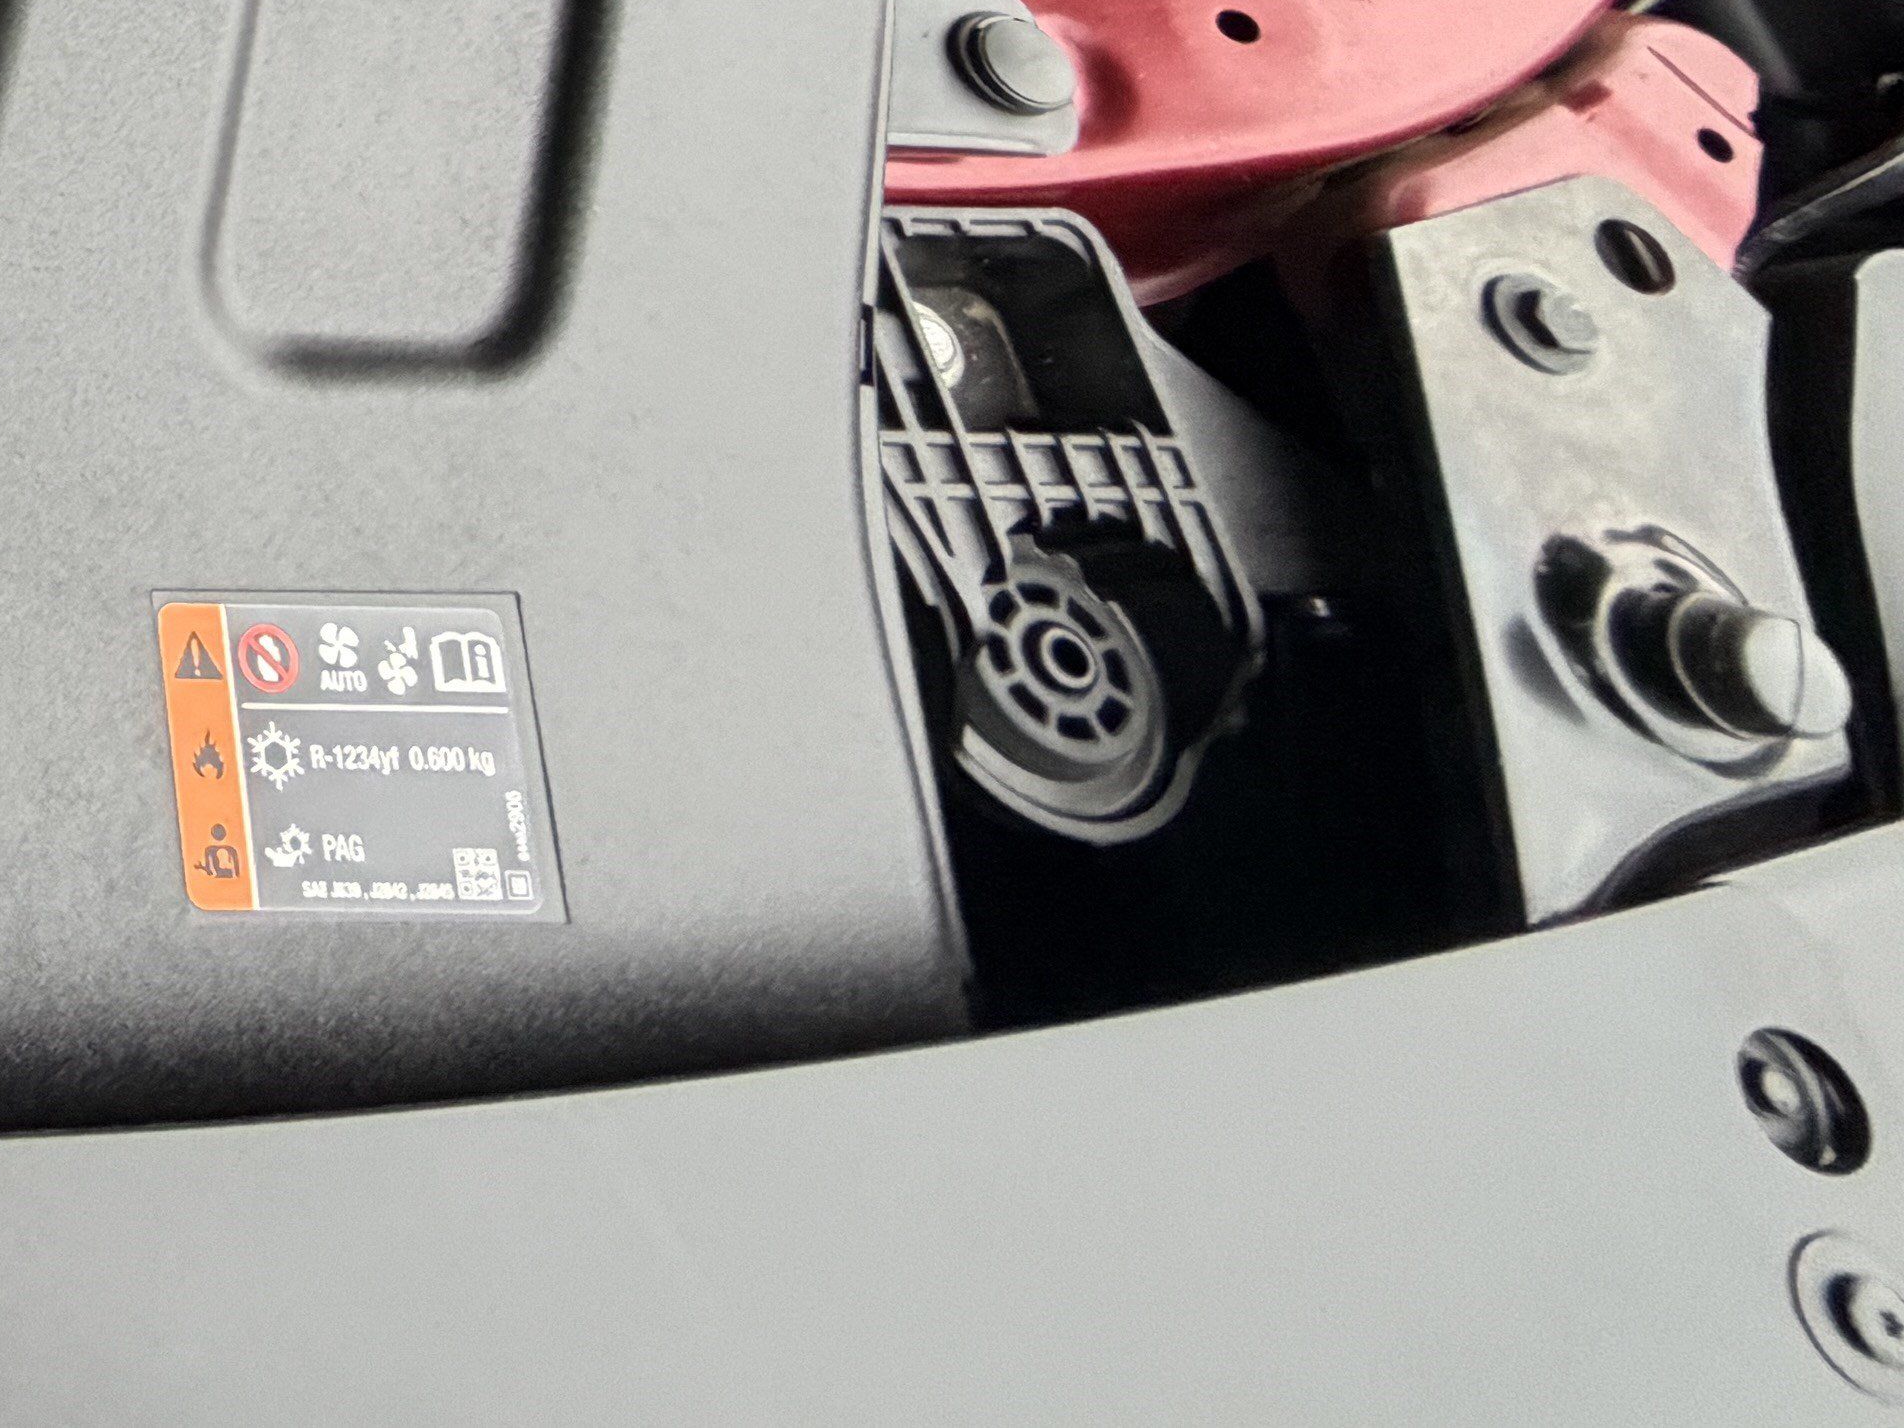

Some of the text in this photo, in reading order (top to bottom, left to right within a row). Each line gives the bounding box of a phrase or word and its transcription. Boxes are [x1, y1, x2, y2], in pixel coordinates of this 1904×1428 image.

[321, 670, 368, 693] AUTO
[310, 744, 496, 777] R-1234yf 0.600 kg
[322, 833, 366, 863] PAG
